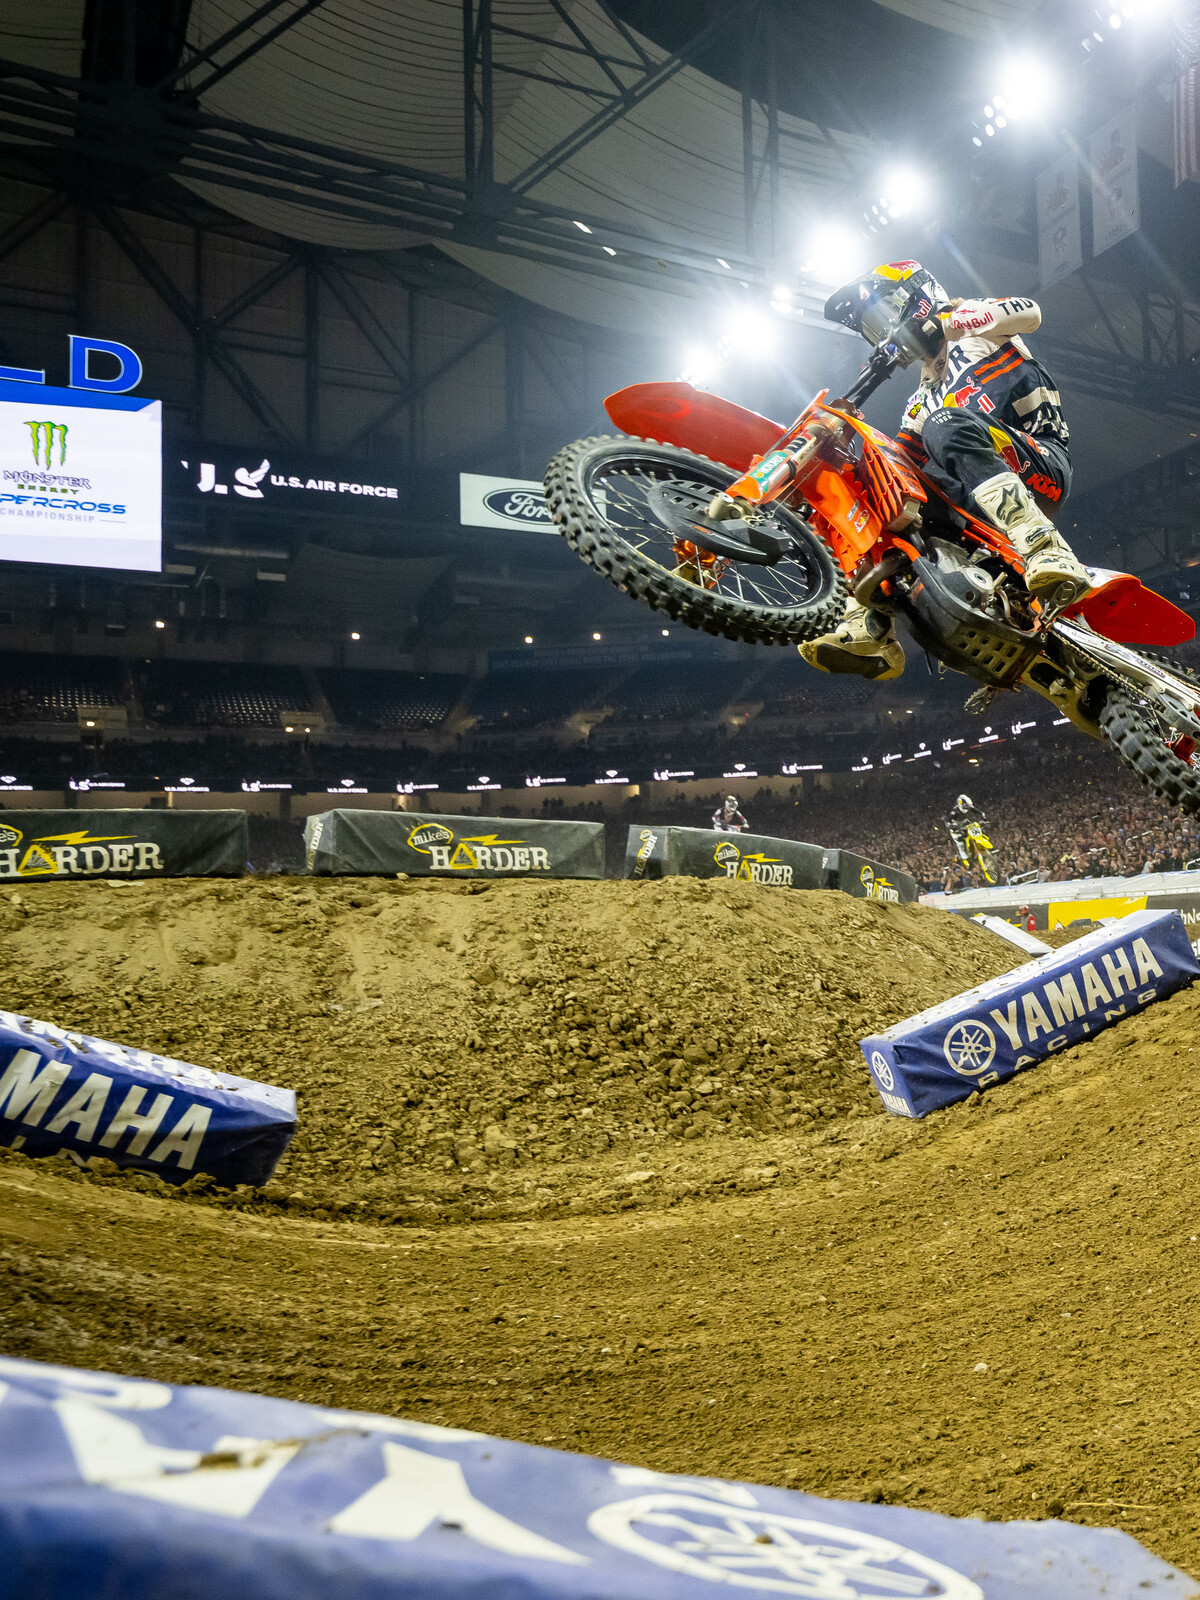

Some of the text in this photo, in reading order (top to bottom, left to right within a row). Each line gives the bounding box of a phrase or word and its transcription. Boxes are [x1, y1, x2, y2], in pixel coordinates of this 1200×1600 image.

[971, 312, 994, 329] Bull
[3, 470, 92, 489] MONSTER
[18, 484, 79, 494] ENERGY
[271, 475, 399, 499] U.S. AIR FORCE
[1025, 473, 1063, 502] KTM
[0, 507, 95, 523] CHAMPIONSHIP
[504, 493, 553, 519] For
[412, 829, 451, 846] mike's
[429, 845, 551, 871] HARDER
[725, 861, 793, 886] HARDER
[990, 937, 1164, 1051] YAMAHA
[978, 988, 1158, 1088] RACING
